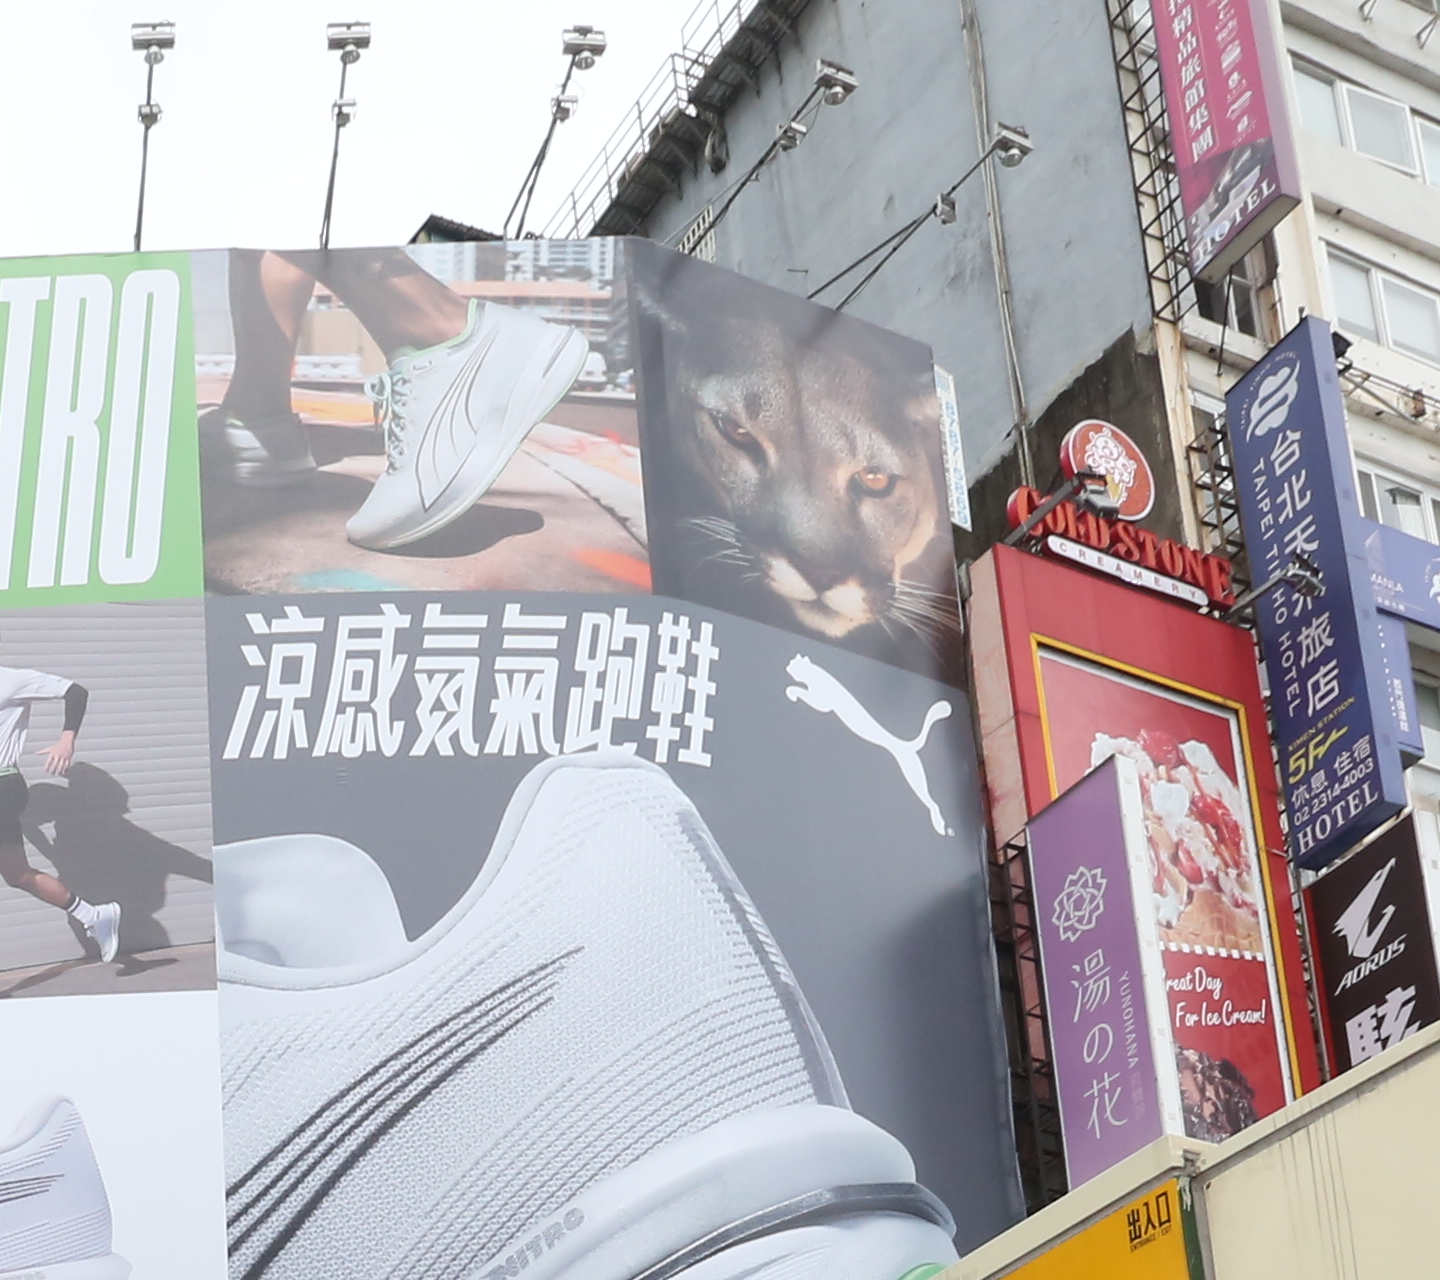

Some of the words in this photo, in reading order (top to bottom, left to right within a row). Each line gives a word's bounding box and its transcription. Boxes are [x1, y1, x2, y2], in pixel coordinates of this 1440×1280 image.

[1167, 0, 1215, 163] 精品旅館集團
[1195, 178, 1277, 261] HOTEL
[1059, 543, 1198, 598] CREAMERY
[1109, 520, 1237, 607] STONE
[1249, 457, 1275, 542] TAIPEI
[1277, 636, 1302, 718] HOTEL
[221, 602, 724, 770] 涼感氮氣跑鞋
[1316, 695, 1356, 730] STATION
[1288, 731, 1327, 785] 5F
[1291, 769, 1329, 810] 休息
[1333, 735, 1371, 776] 住宿
[1294, 806, 1311, 826] 02
[1311, 758, 1375, 814] 2314-4003
[1297, 780, 1380, 856] HOTEL
[1164, 967, 1194, 992] reat
[1194, 966, 1222, 1000] Day
[1333, 934, 1408, 996] AORUS
[1071, 948, 1128, 1140] 湯の花
[1118, 970, 1140, 1070] YUNOHANA
[1175, 1001, 1200, 1028] For
[1201, 1001, 1221, 1026] Ice
[1221, 998, 1267, 1027] Cream!
[1126, 1191, 1172, 1245] 出入口
[1129, 1233, 1156, 1253] ENTRANCE
